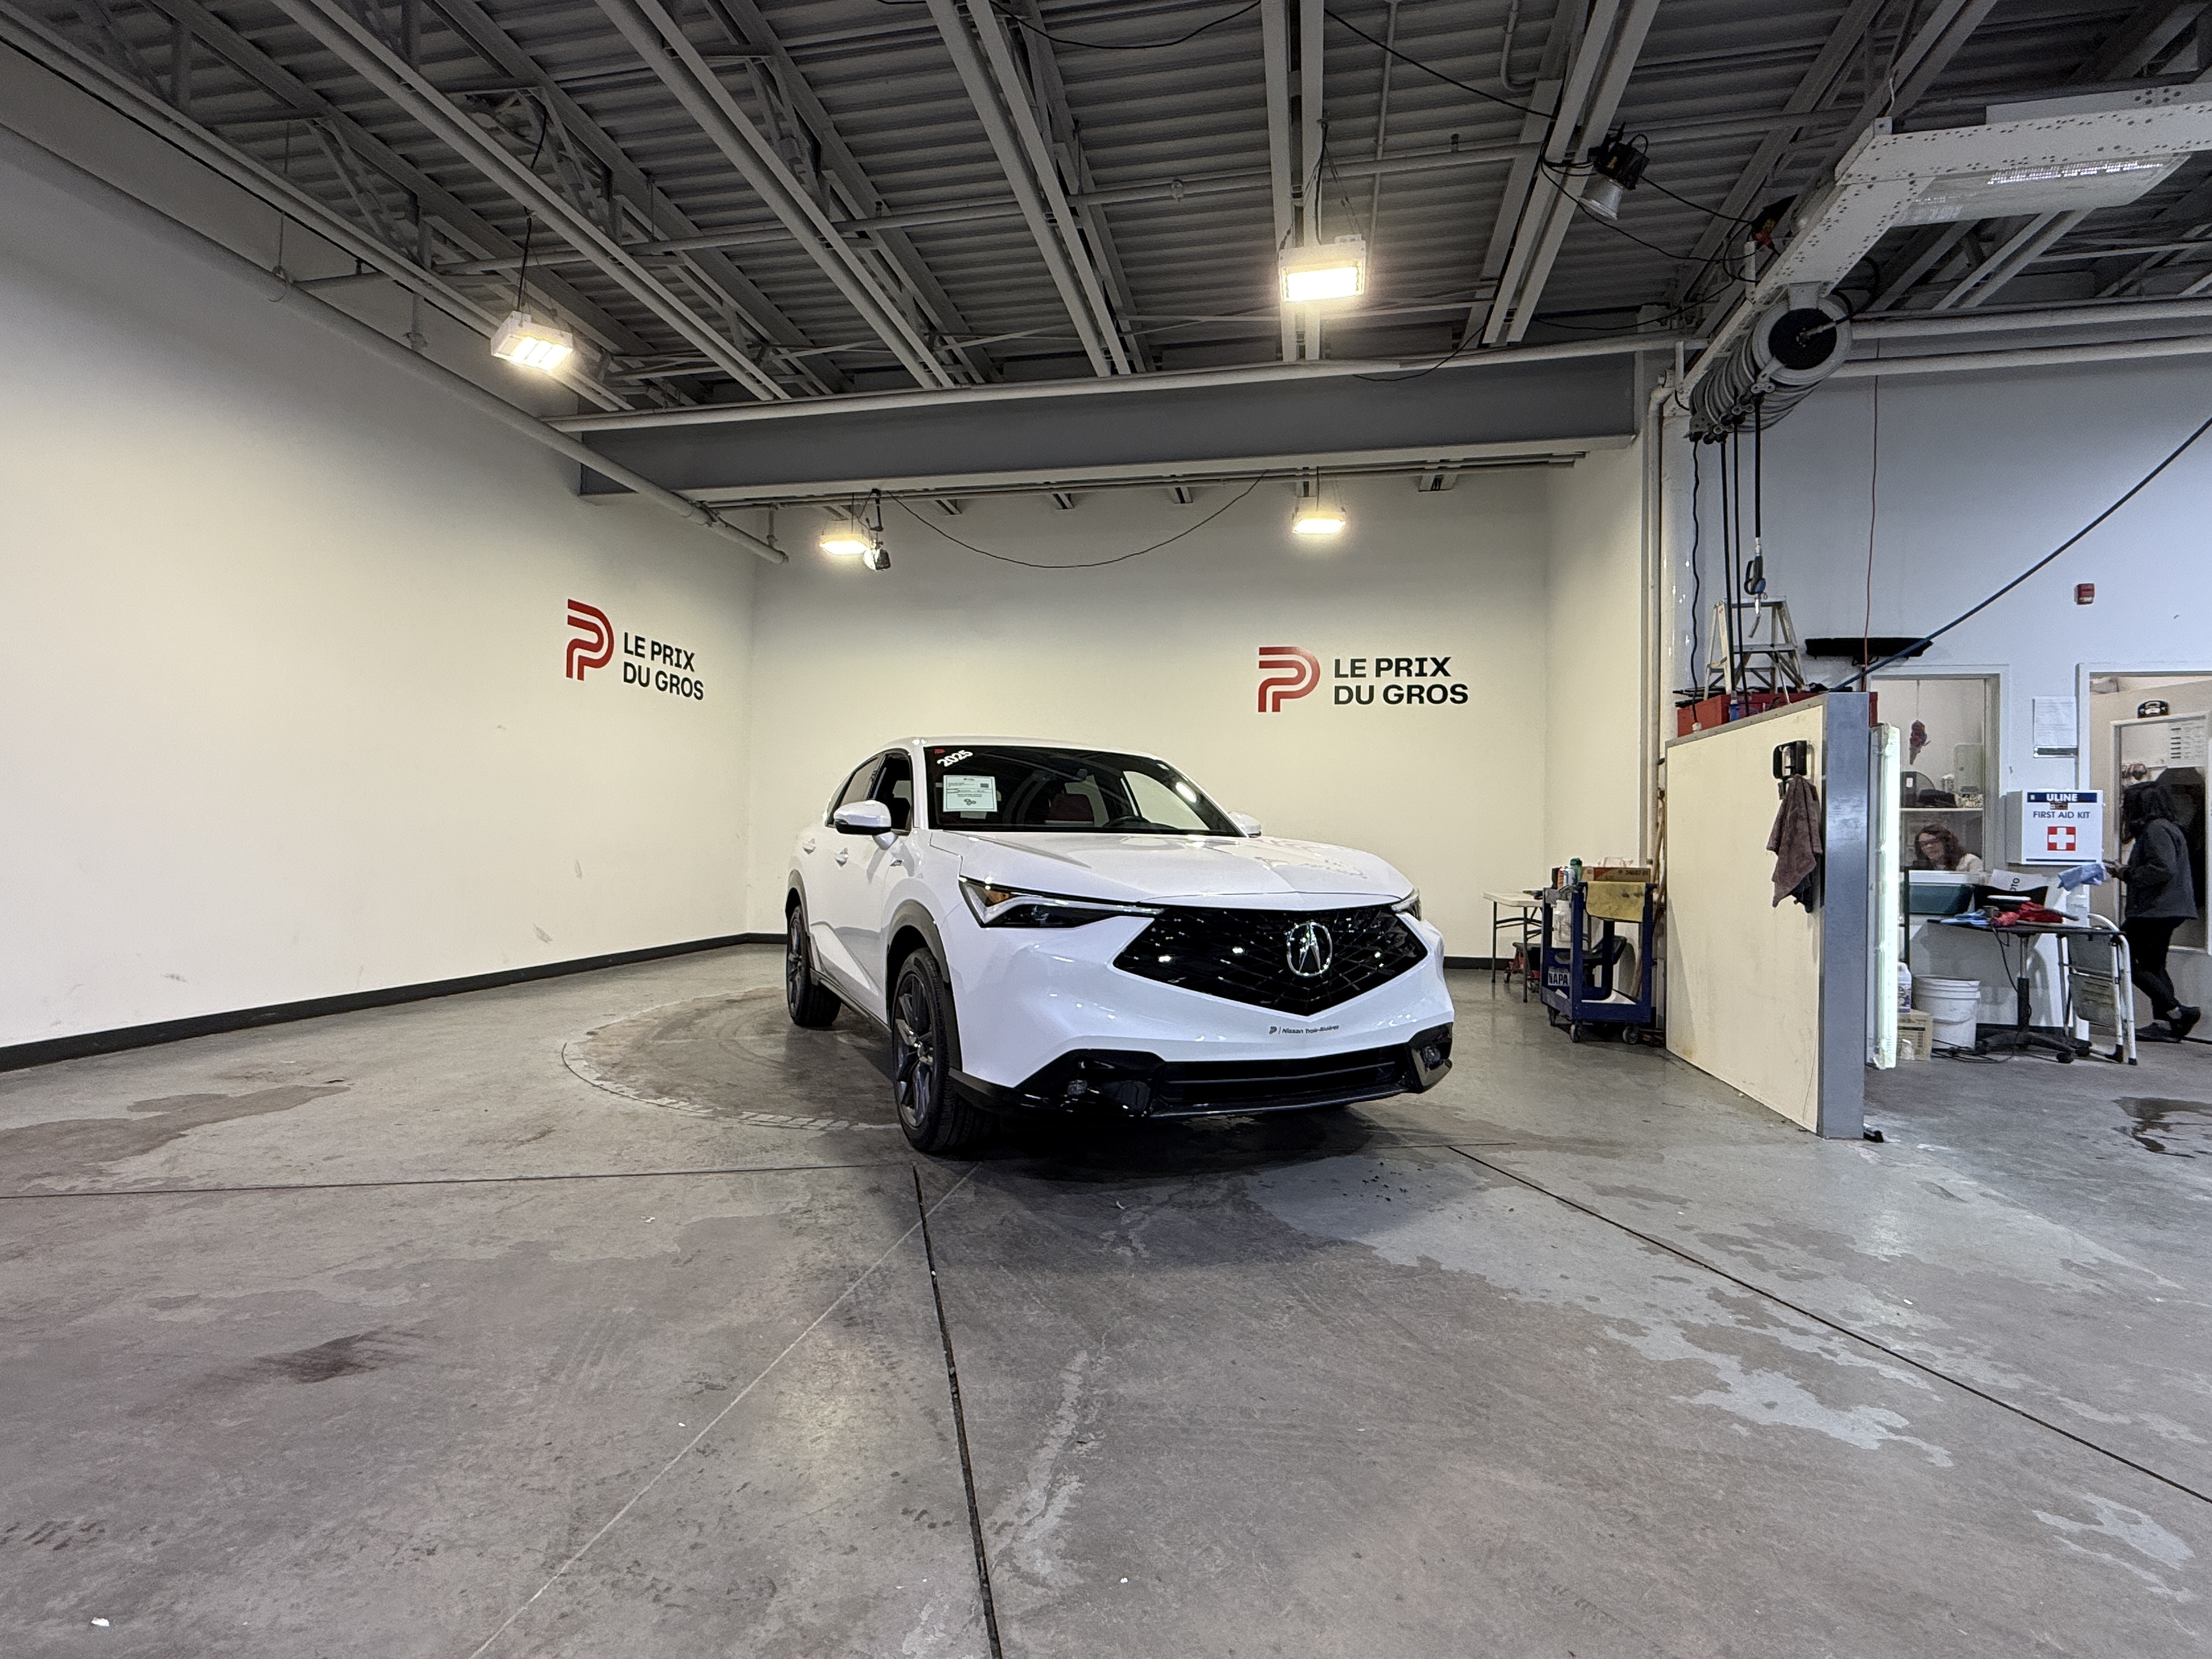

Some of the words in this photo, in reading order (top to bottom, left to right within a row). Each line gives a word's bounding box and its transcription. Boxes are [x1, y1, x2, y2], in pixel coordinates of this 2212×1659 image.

[624, 632, 646, 659] LE
[651, 640, 695, 673] PRIX
[1334, 658, 1367, 678] LE
[1375, 656, 1452, 678] PRIX
[623, 661, 651, 688] DU
[656, 670, 704, 701] GROS
[1334, 684, 1375, 705] DU
[1383, 683, 1469, 705] GROS
[936, 749, 973, 767] 2025
[2046, 793, 2078, 802] ULINE
[1548, 973, 1568, 986] NAPA
